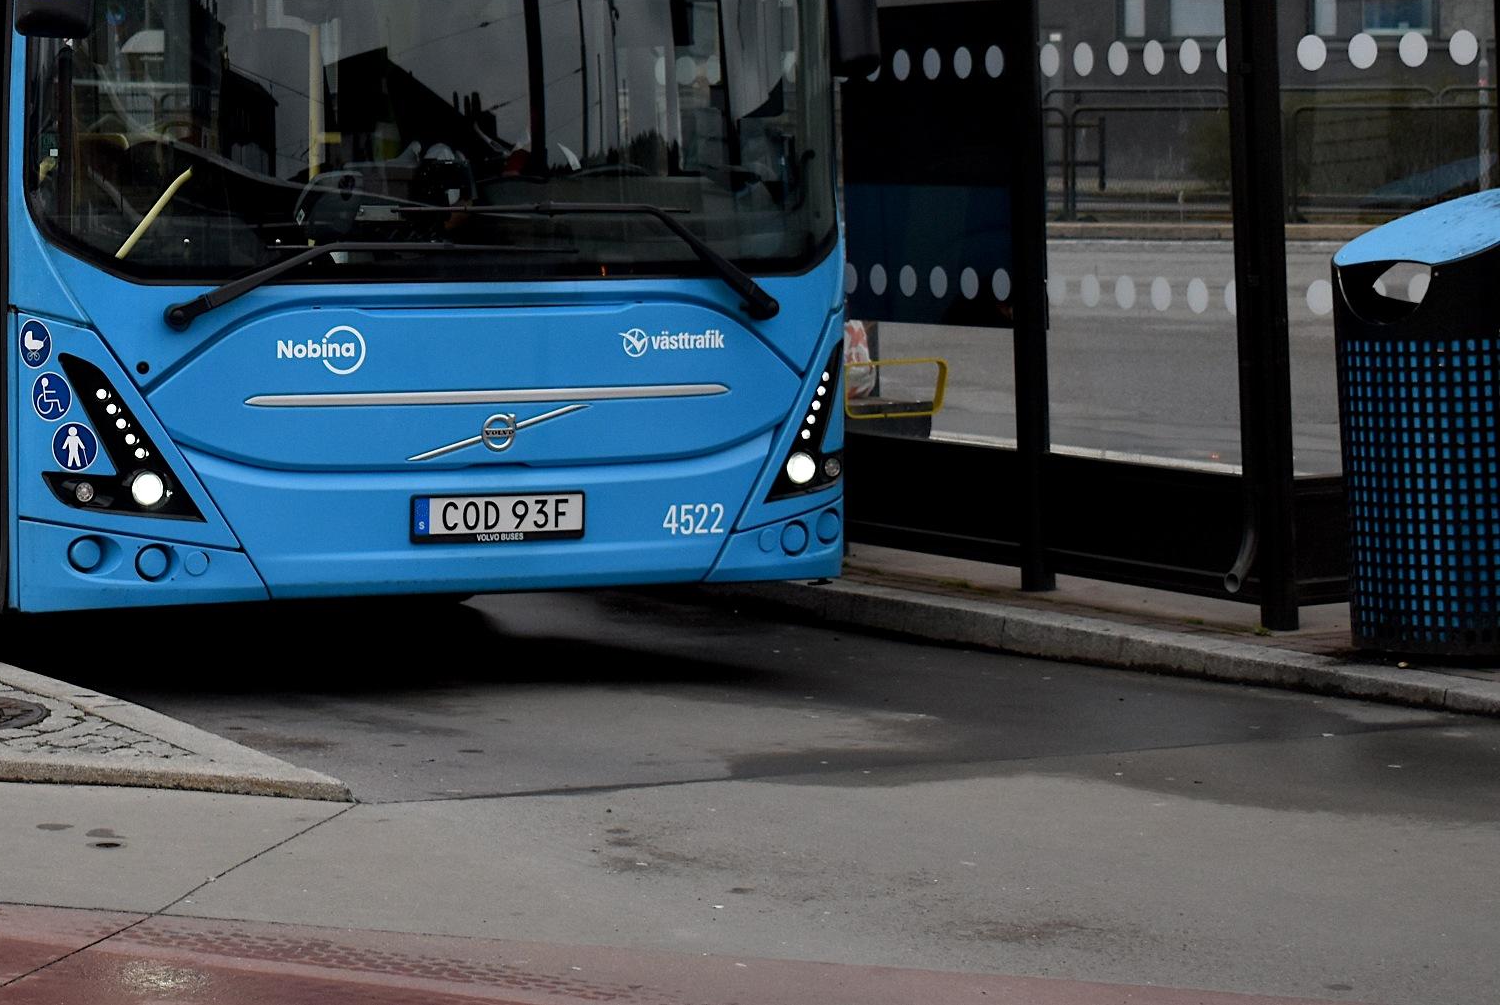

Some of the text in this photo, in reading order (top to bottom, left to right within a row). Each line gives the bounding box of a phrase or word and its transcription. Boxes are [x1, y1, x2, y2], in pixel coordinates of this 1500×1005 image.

[276, 339, 355, 360] Nobina
[651, 330, 725, 351] västtrafik
[484, 429, 515, 437] VOLVO
[418, 499, 569, 531] S COD 93F
[662, 503, 724, 535] 4522
[476, 532, 524, 542] VOLVO BUSES
